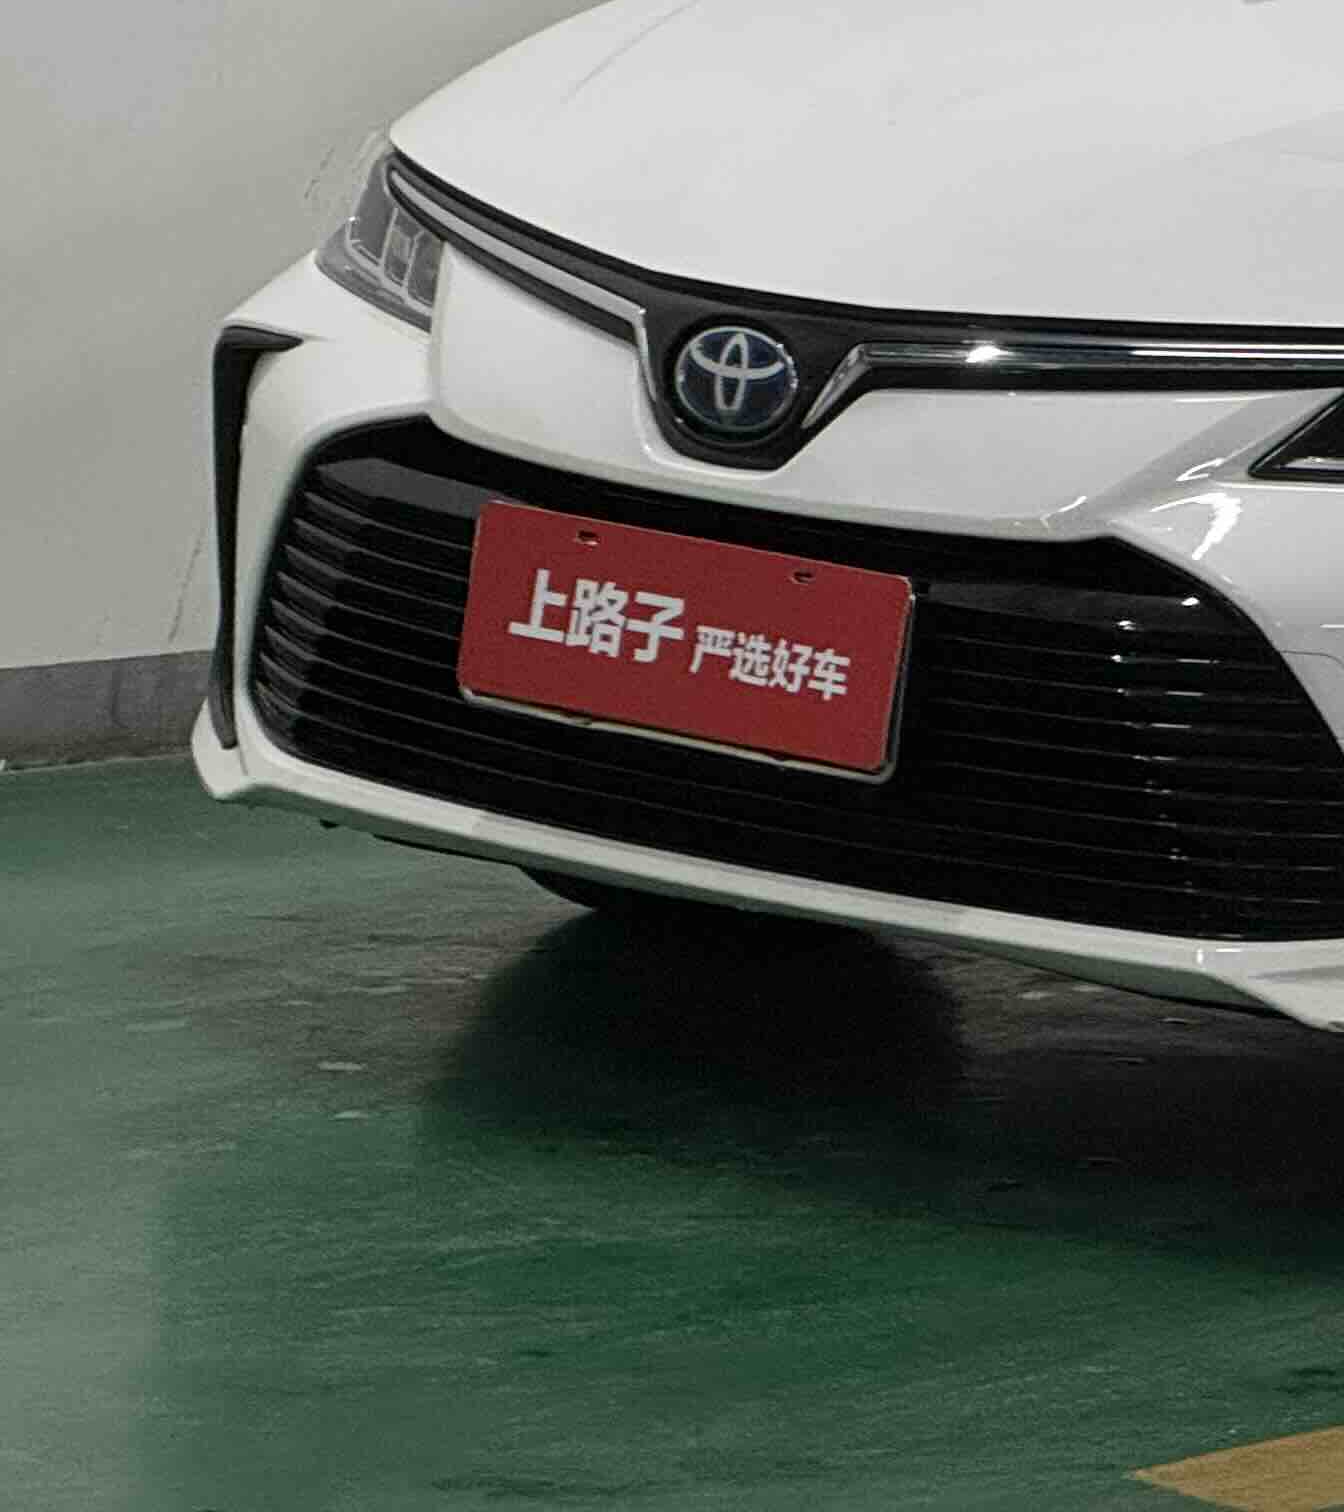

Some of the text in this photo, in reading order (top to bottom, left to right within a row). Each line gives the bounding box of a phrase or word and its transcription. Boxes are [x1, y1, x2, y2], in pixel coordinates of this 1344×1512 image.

[507, 568, 850, 702] 上路子 严选好车
